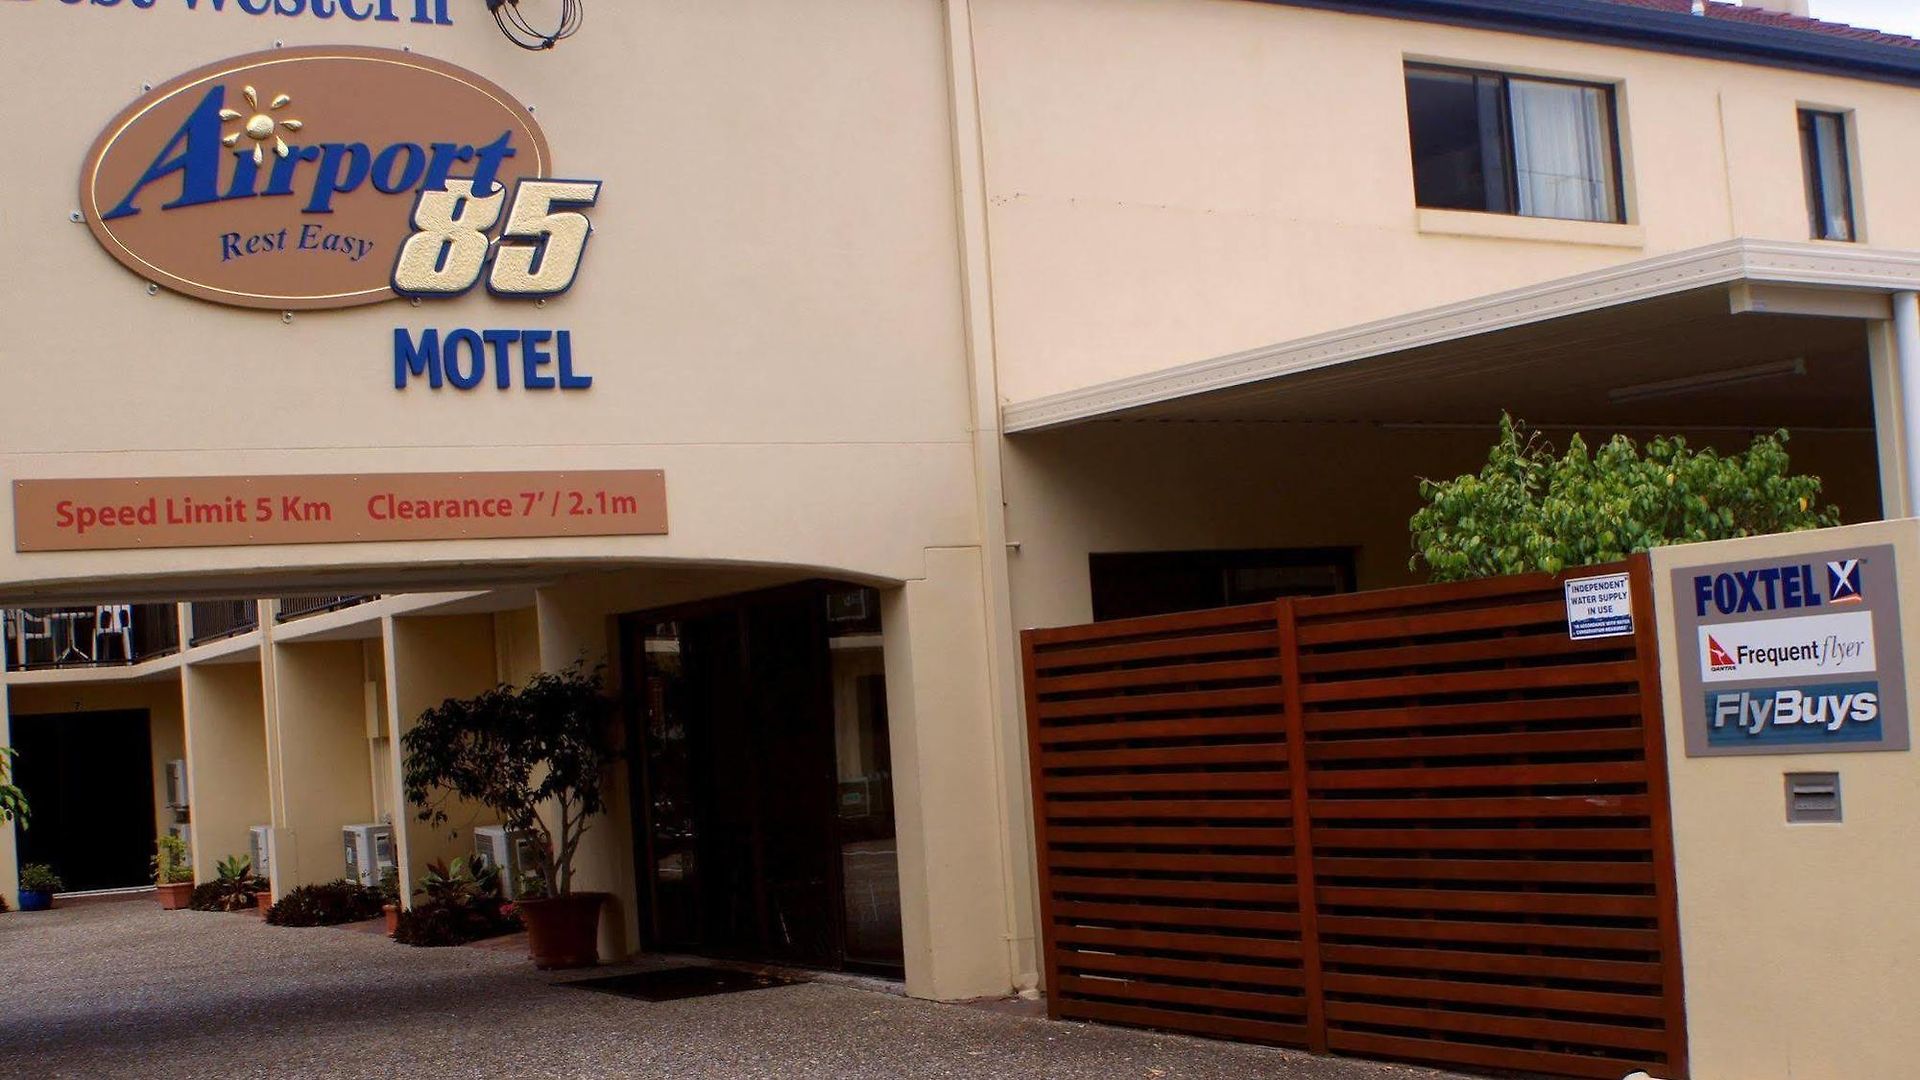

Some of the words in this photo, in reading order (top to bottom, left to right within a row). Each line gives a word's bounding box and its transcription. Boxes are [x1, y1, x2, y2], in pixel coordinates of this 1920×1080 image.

[102, 84, 516, 220] Airport
[220, 231, 287, 262] Rest
[298, 223, 374, 262] Easy
[390, 177, 603, 299] 85
[393, 328, 593, 390] MOTEL
[56, 497, 156, 534] Speed
[166, 496, 247, 525] Limit
[255, 497, 272, 521] 5
[282, 495, 332, 522] Km
[367, 493, 512, 520] Clearance
[568, 491, 637, 516] 2.1m
[1571, 595, 1597, 605] WATER
[1598, 592, 1627, 602] SUPPLY
[1572, 580, 1624, 592] INDEPENDENT
[1694, 564, 1821, 617] FOXTEL
[1588, 606, 1596, 615] IN
[1598, 605, 1613, 614] USE
[1737, 640, 1819, 667] Frequent
[1817, 634, 1865, 667] flyer
[1714, 689, 1878, 735] FlyBuys
